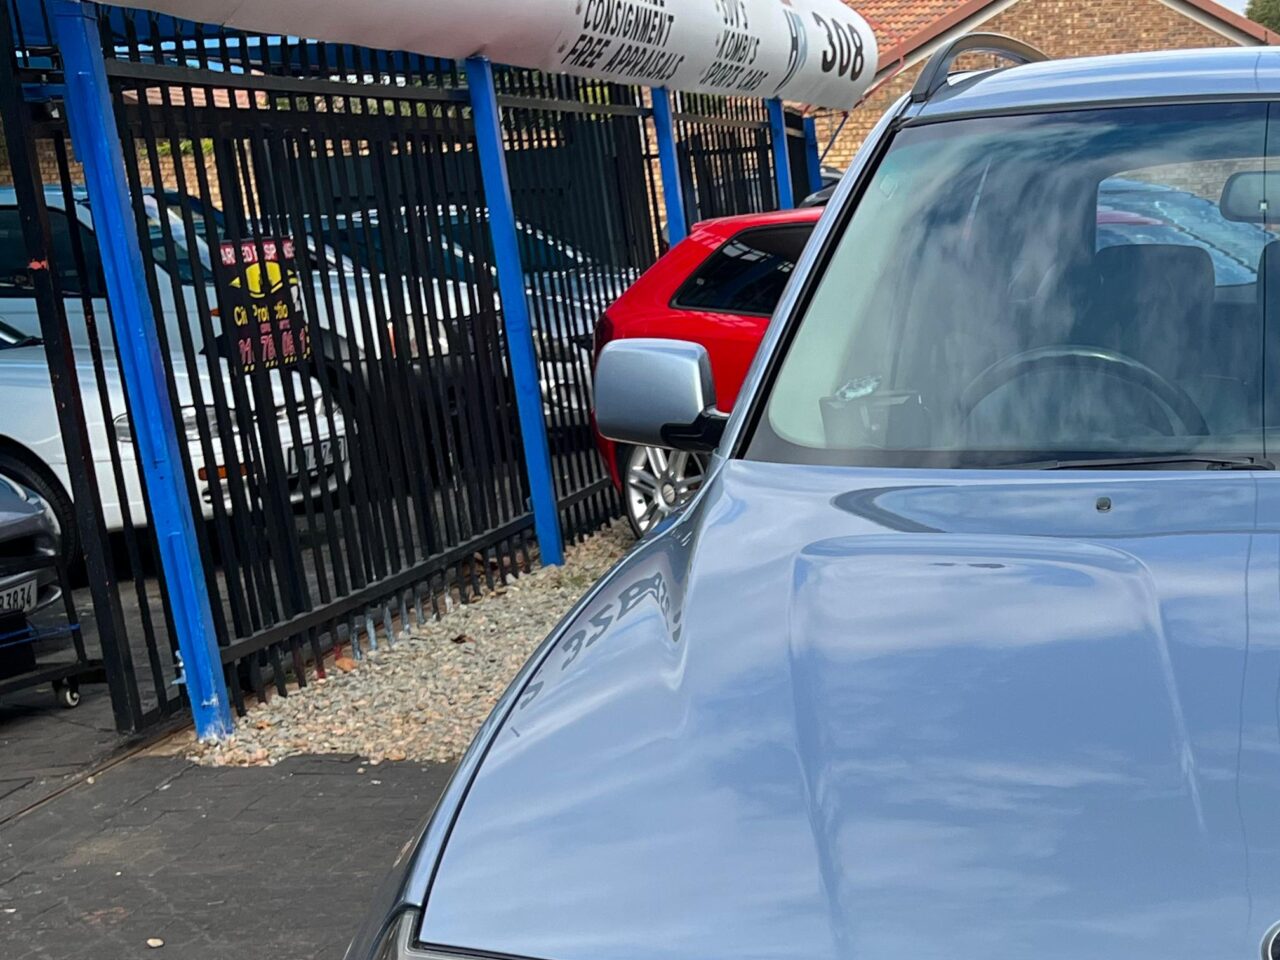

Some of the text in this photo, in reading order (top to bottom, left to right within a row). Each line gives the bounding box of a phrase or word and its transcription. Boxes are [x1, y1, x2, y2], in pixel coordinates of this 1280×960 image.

[583, 0, 675, 48] CONSIGNMENT
[811, 10, 864, 82] 308
[560, 33, 685, 81] FREE APPRAISALS
[699, 61, 746, 90] SPORTS
